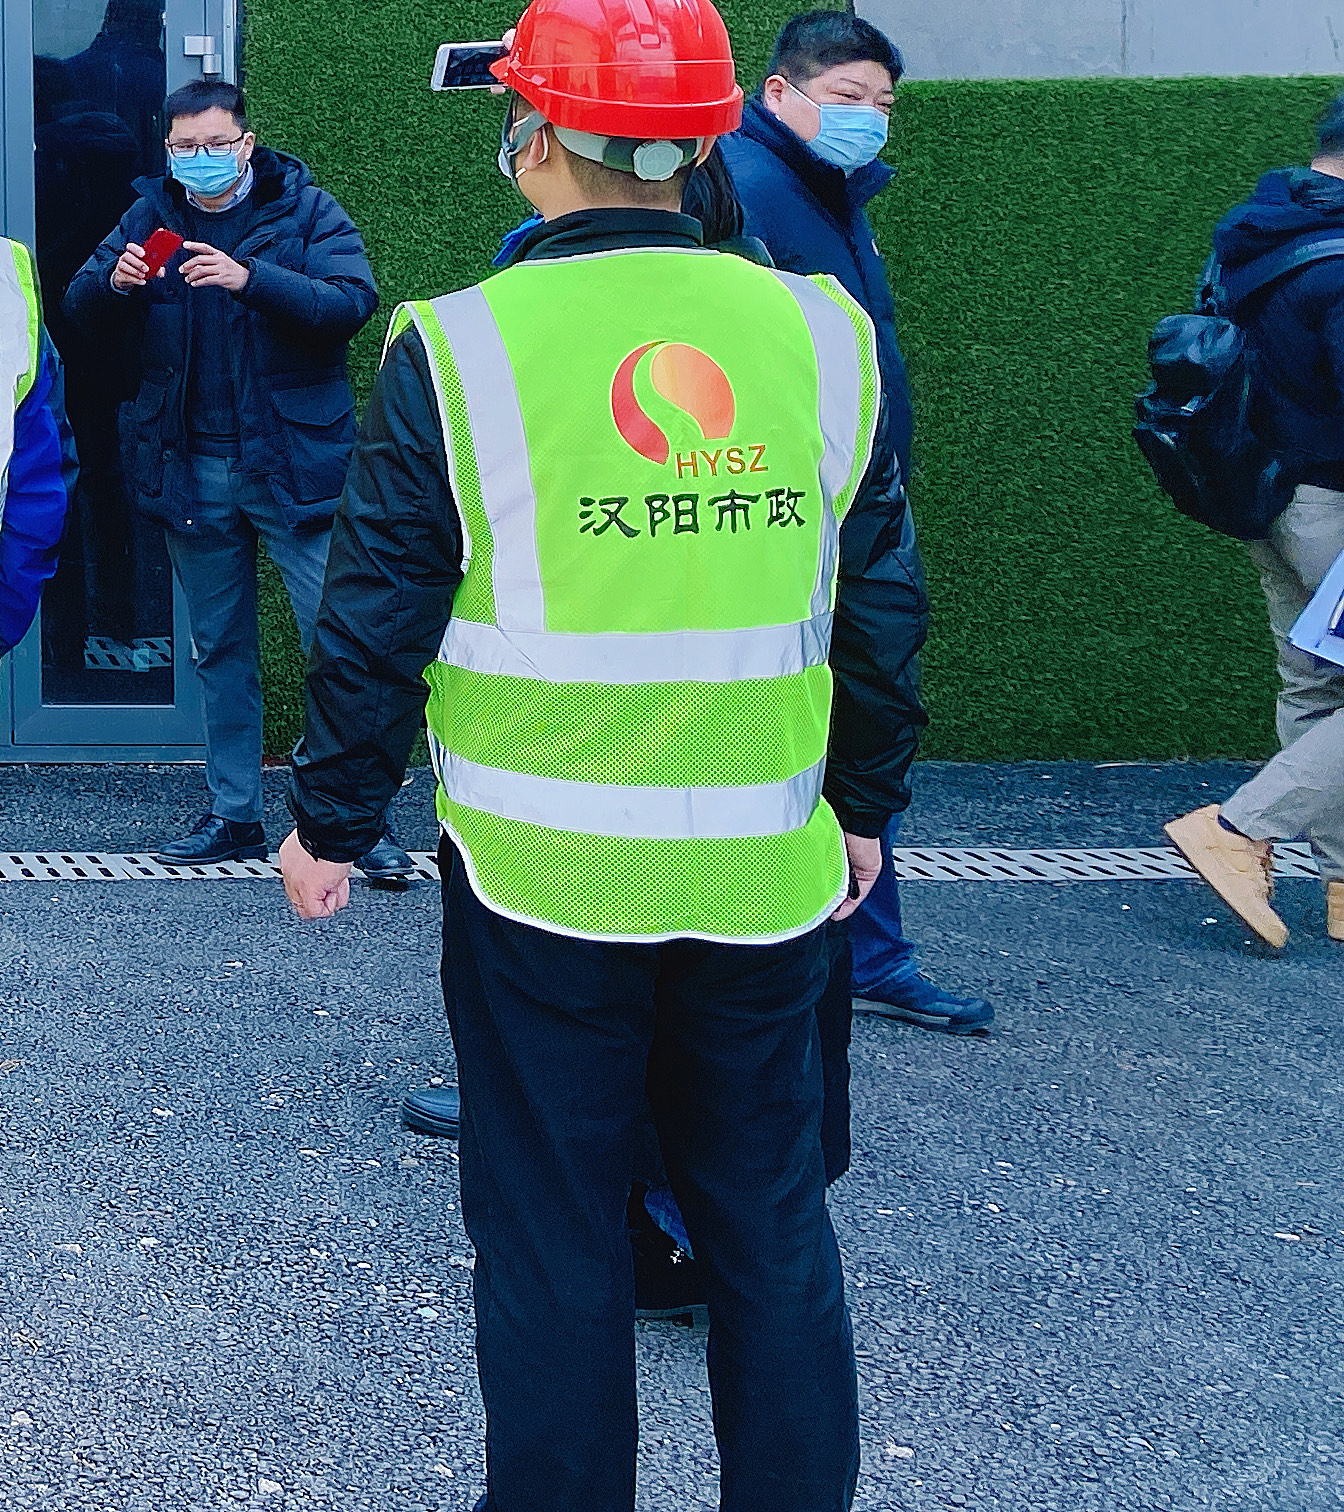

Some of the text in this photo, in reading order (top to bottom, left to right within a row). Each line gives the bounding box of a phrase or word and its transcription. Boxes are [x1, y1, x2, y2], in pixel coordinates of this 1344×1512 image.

[675, 444, 769, 479] HYSZ
[578, 487, 806, 538] 汉阳市政
